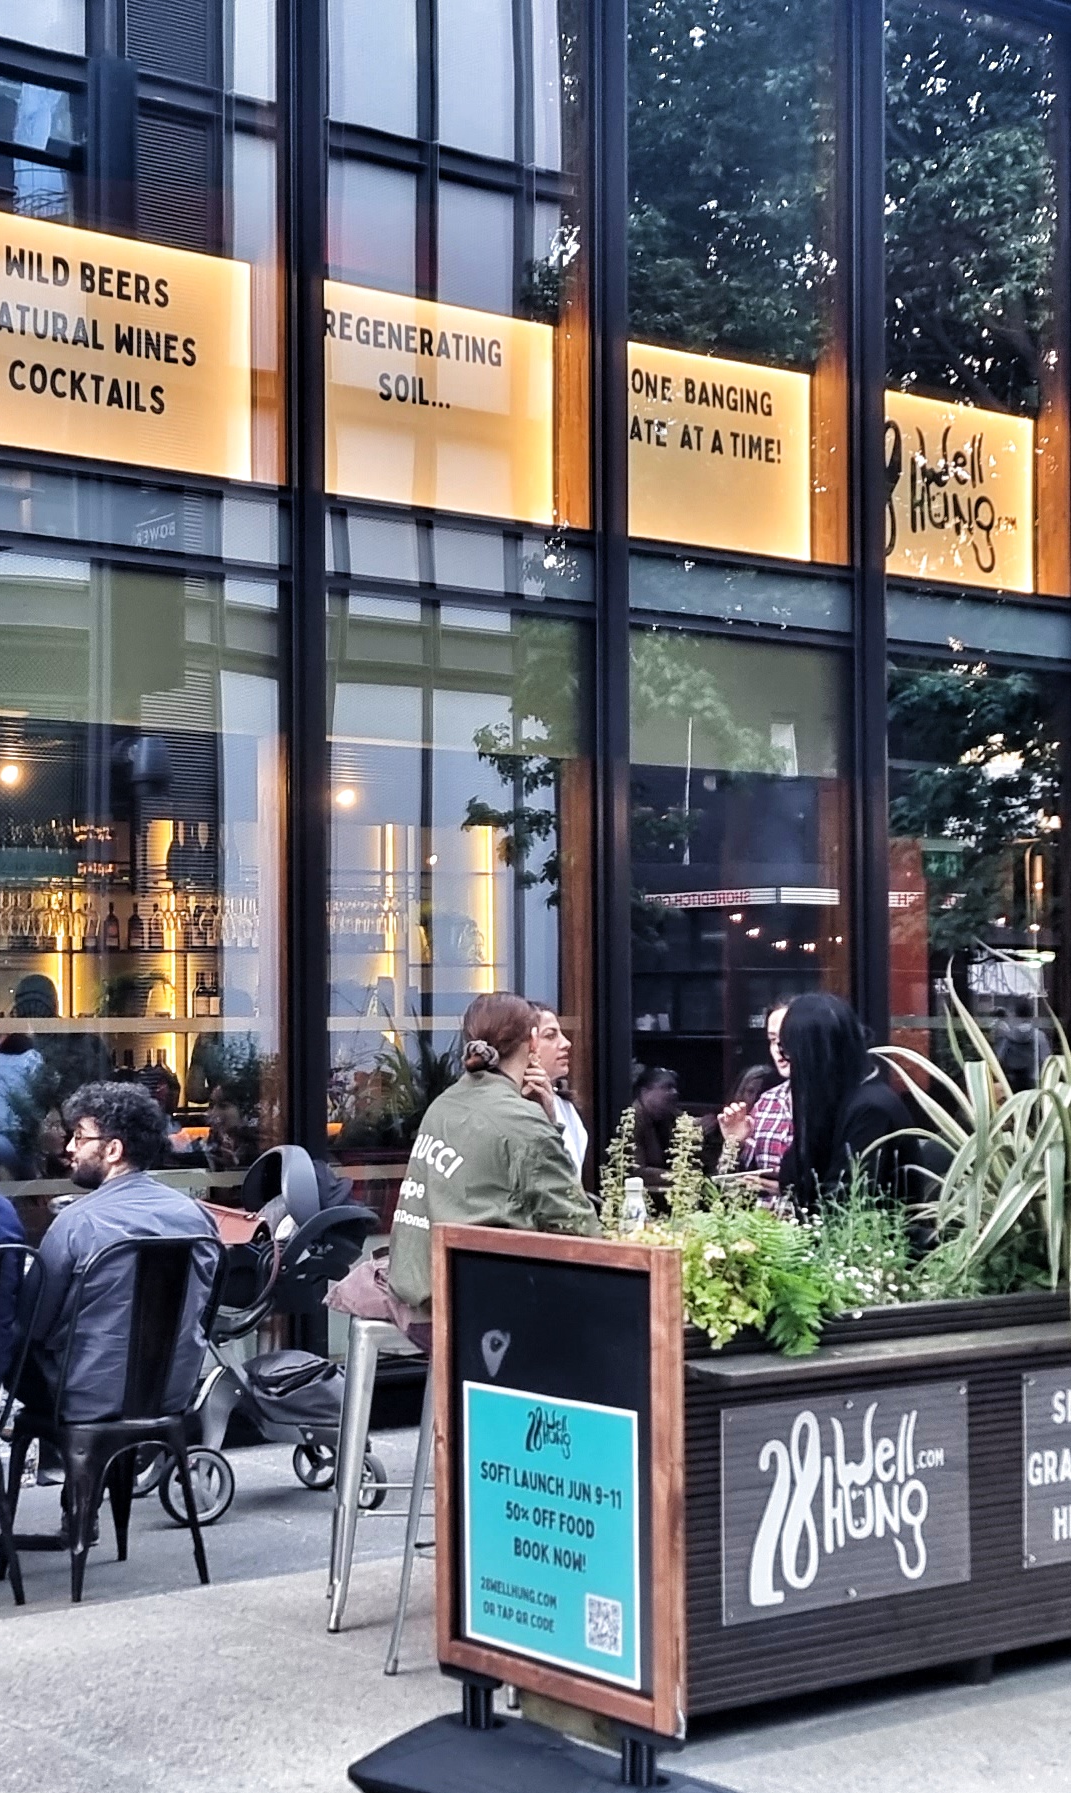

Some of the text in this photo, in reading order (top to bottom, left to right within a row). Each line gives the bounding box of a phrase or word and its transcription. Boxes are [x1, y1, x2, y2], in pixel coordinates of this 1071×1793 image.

[5, 245, 170, 309] WILD BEERS
[115, 323, 197, 367] WINES
[324, 309, 502, 367] REGENERATING
[9, 359, 166, 415] COCKTAILS
[379, 372, 451, 409] SOIL...
[631, 368, 773, 417] ONE BANGING
[680, 424, 704, 452] AT
[711, 429, 724, 455] A
[730, 431, 781, 464] TIME!
[525, 1406, 543, 1452] 28
[1050, 1390, 1071, 1425] S
[480, 1460, 622, 1510] SOFT LAUNCH JUN 9-11
[750, 1410, 821, 1606] 28
[830, 1402, 918, 1486] Well
[505, 1500, 595, 1539] 50% OFF FOOD
[1051, 1504, 1071, 1542] H
[513, 1536, 586, 1573] BOOK NOW!
[483, 1600, 555, 1634] OR TAP QR CODE
